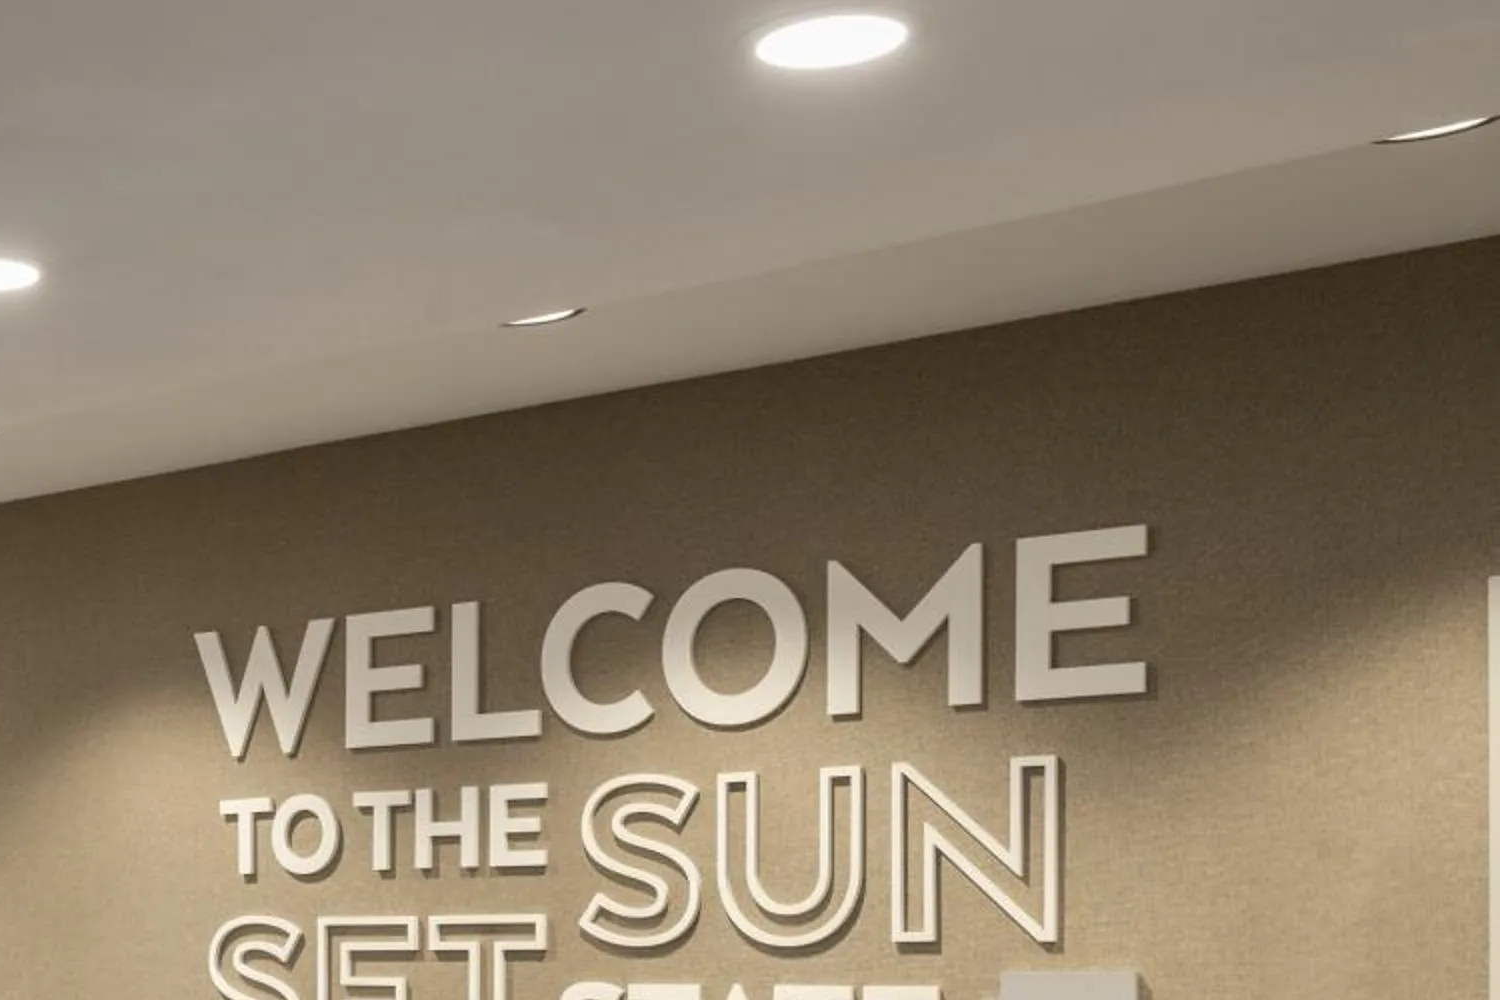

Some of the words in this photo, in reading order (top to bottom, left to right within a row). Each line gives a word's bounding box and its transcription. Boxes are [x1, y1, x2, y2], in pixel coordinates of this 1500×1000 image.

[194, 524, 1149, 758] WELCOME
[218, 793, 338, 876] TO
[352, 782, 548, 871] THE
[578, 755, 1058, 948] SUN
